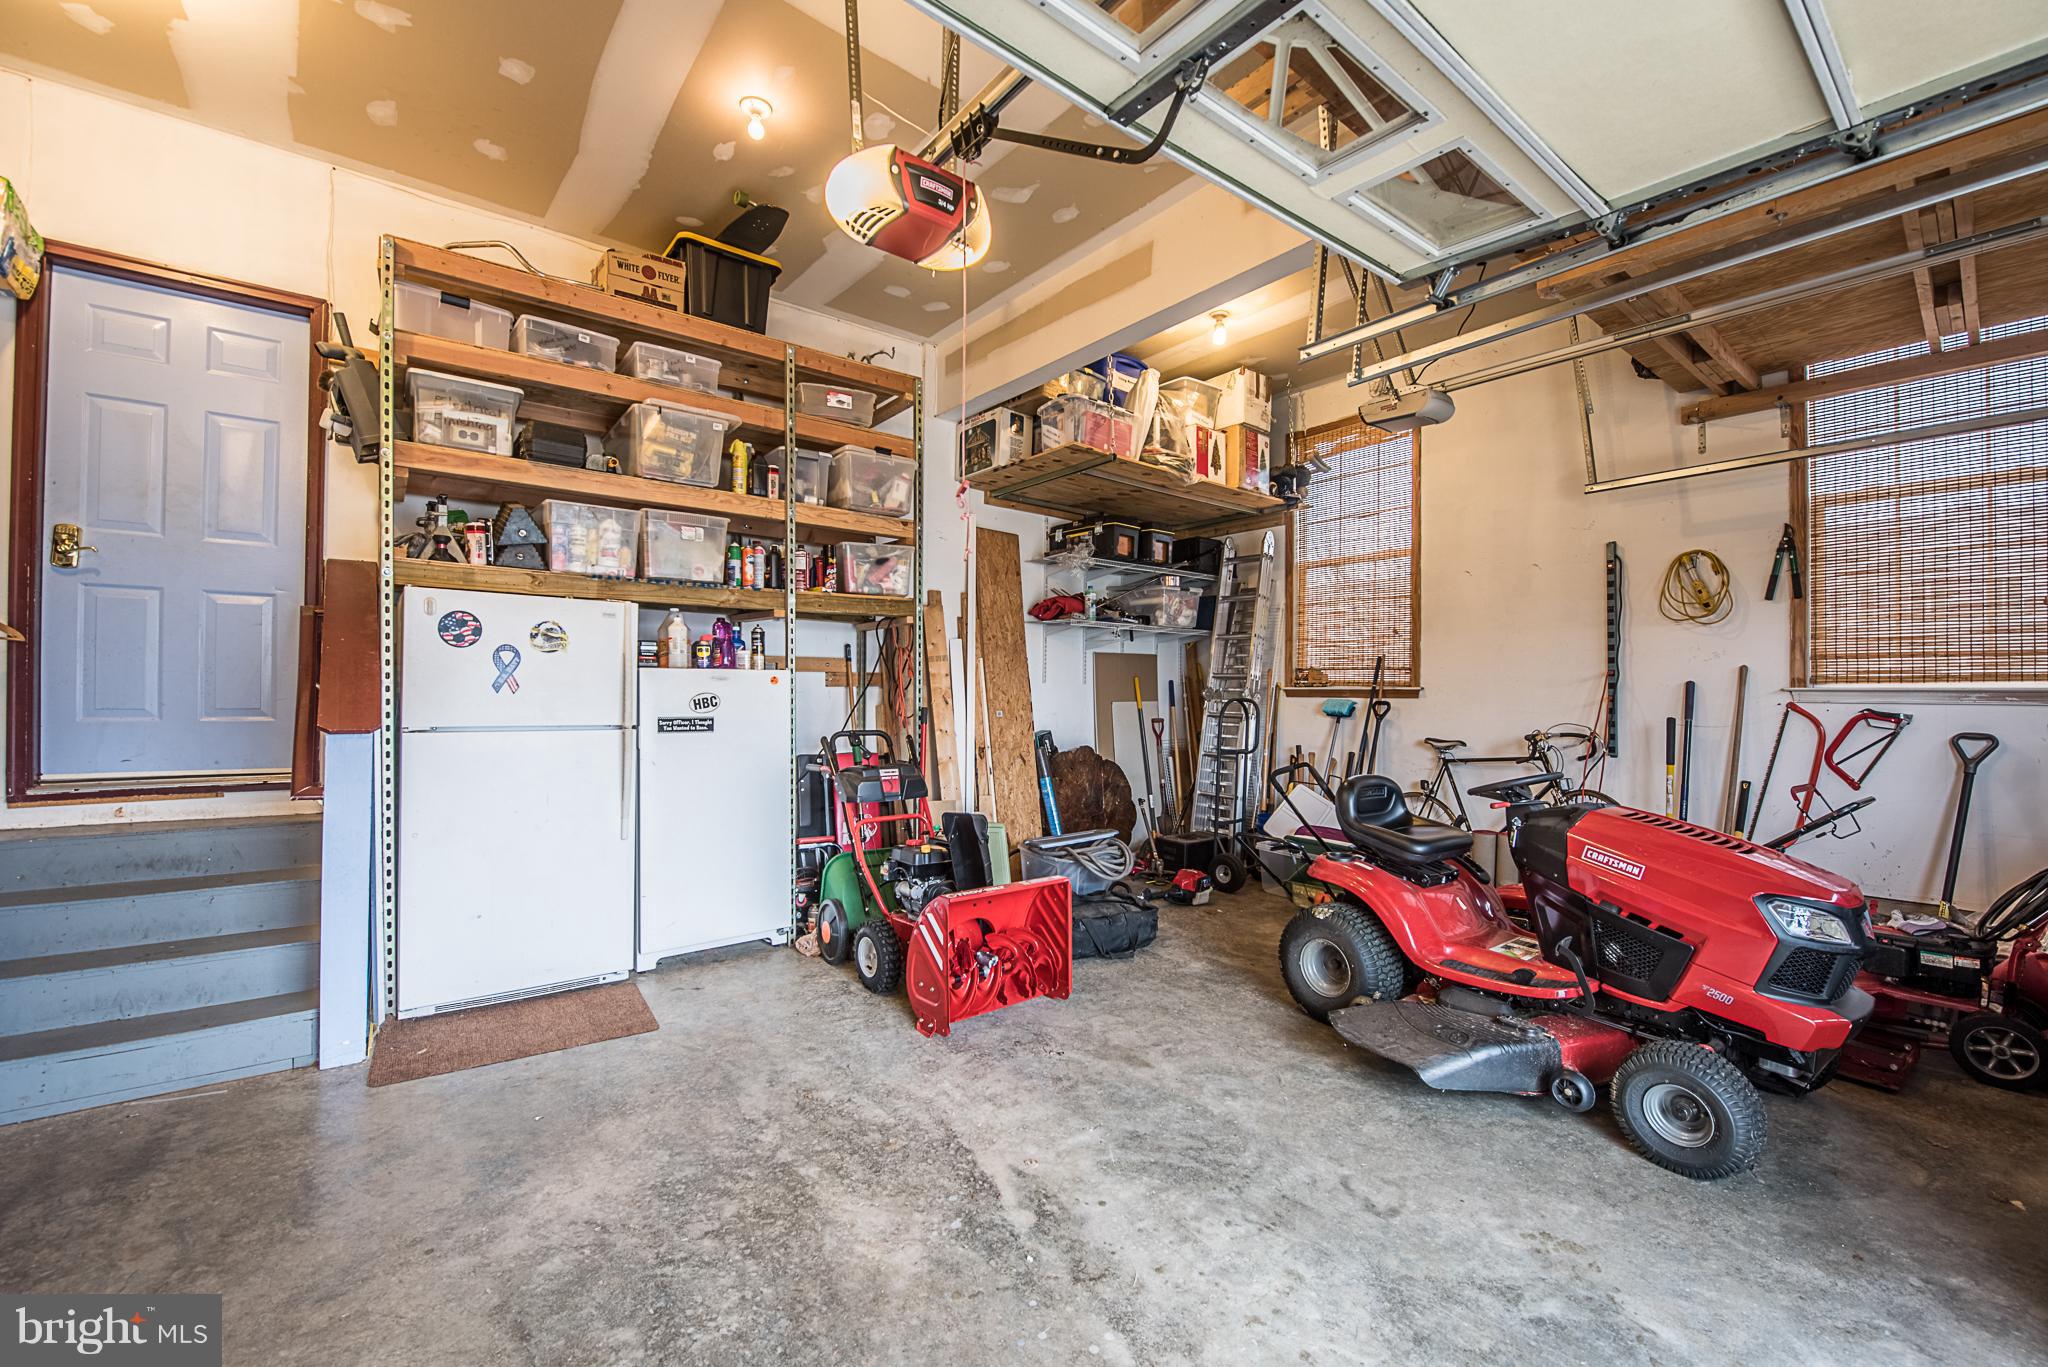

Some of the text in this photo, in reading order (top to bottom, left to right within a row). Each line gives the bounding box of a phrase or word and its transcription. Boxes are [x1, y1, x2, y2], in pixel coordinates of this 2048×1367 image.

[617, 260, 640, 273] WHITE
[658, 271, 680, 284] FLYER
[693, 695, 718, 711] HBC
[1586, 850, 1641, 876] CRAFTSMAN
[1706, 988, 1735, 1006] 2500
